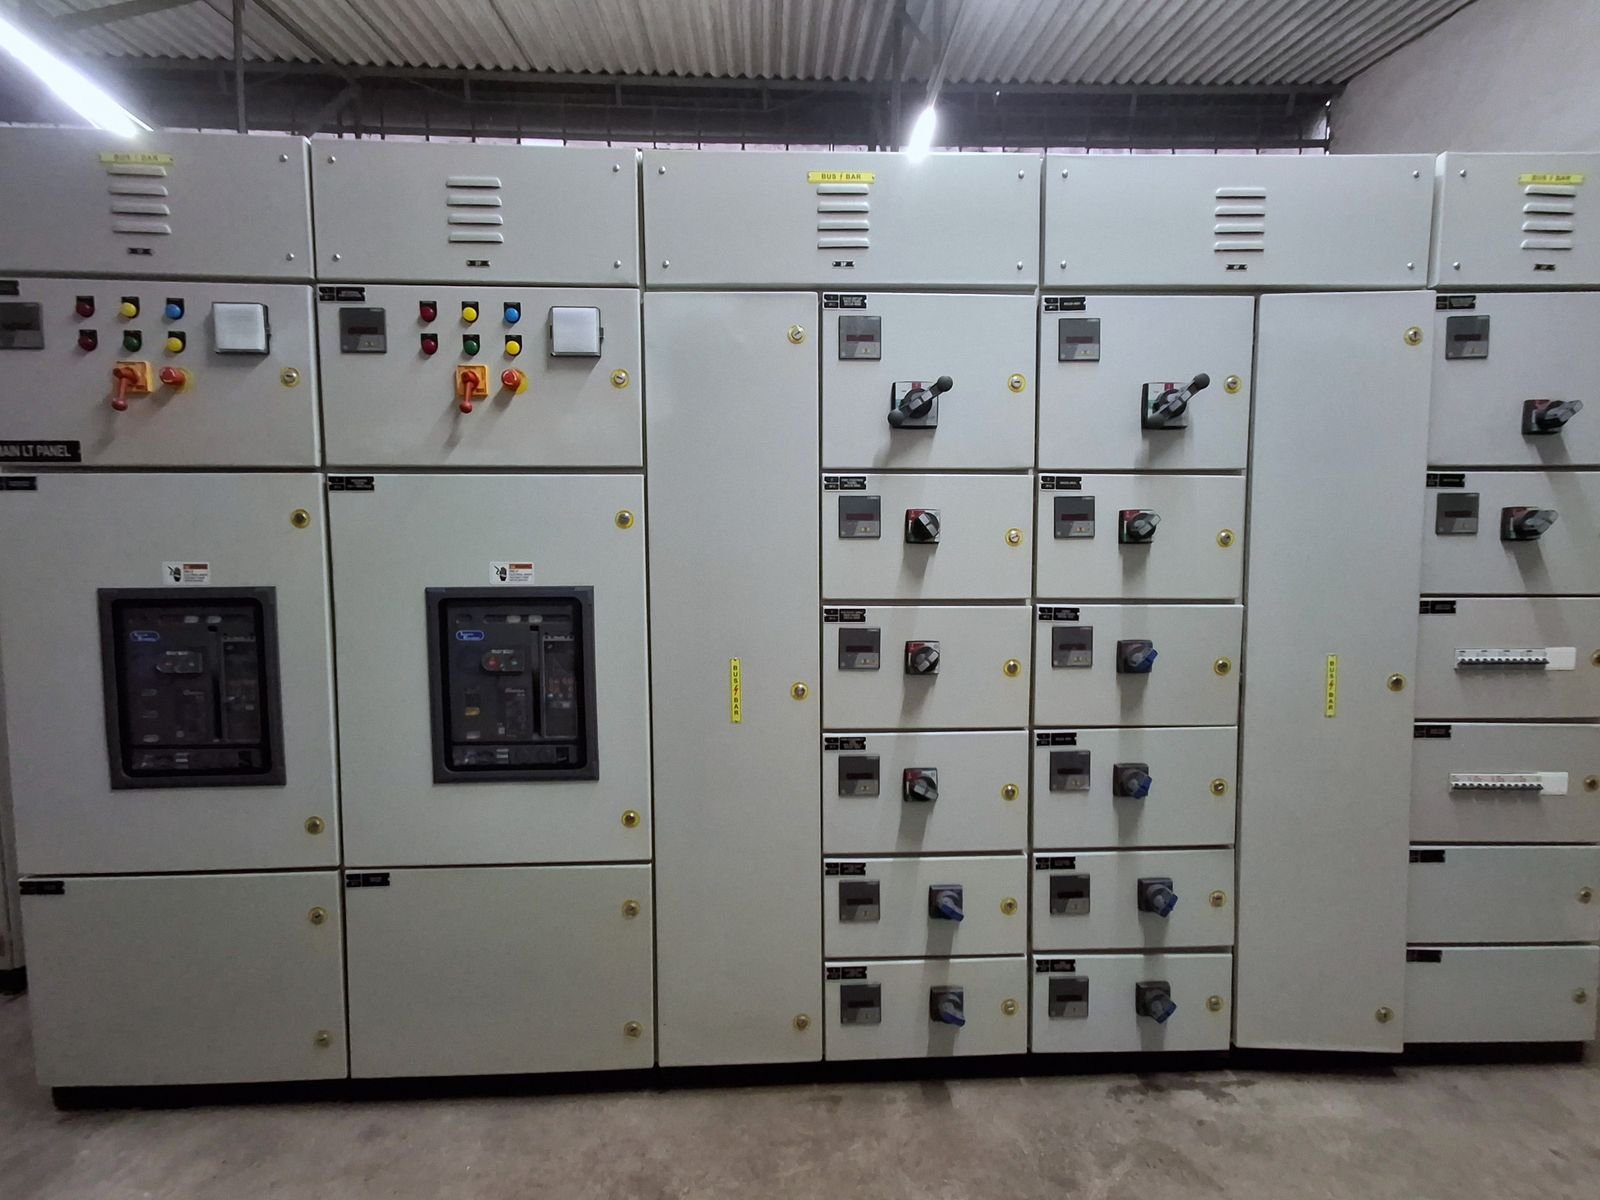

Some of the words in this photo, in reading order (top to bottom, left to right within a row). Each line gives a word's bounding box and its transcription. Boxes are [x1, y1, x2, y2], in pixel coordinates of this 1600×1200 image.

[0, 445, 20, 457] AIN
[22, 445, 34, 457] LT
[36, 445, 72, 457] PANEL
